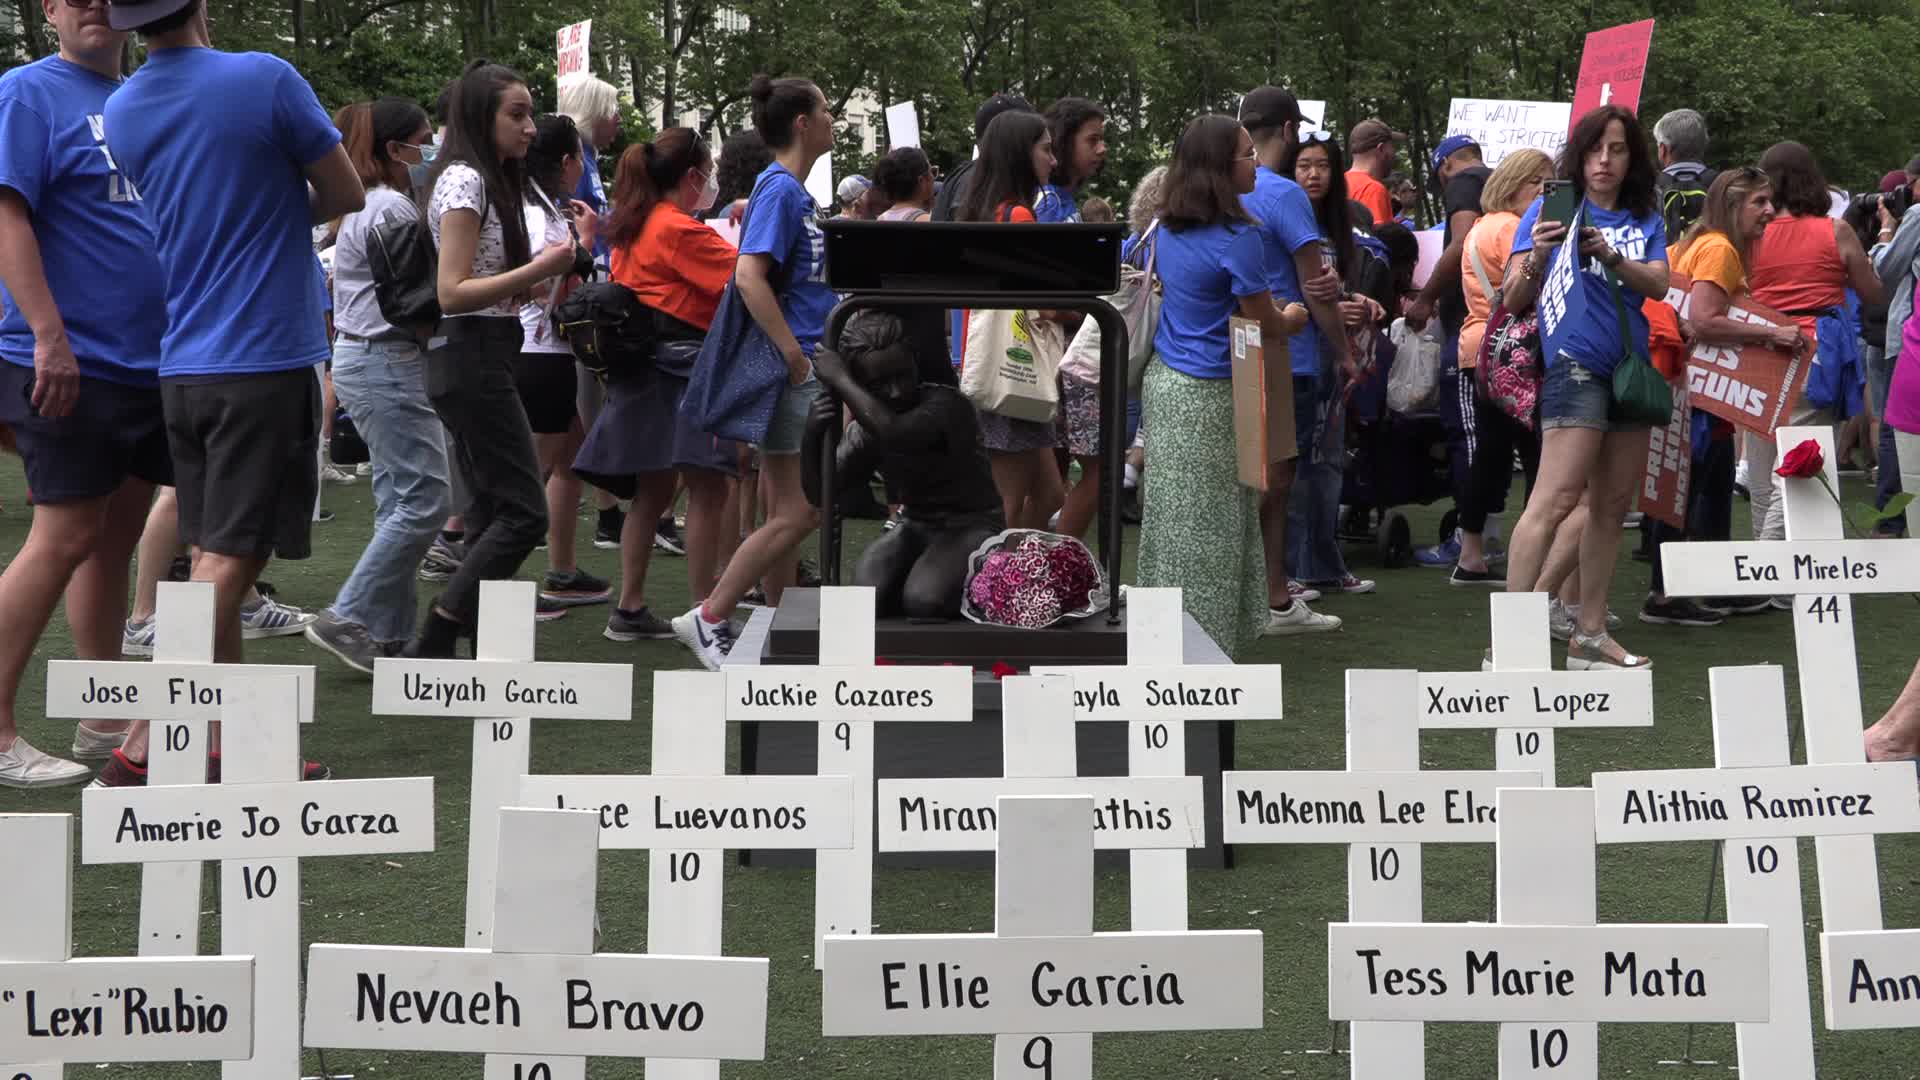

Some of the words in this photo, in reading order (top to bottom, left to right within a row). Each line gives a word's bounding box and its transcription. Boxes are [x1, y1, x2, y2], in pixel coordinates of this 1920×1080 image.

[1452, 102, 1475, 121] WE
[1485, 103, 1537, 124] WANT
[1686, 364, 1768, 418] GUNS
[1734, 555, 1779, 581] Eva
[1793, 554, 1878, 580] Mireles
[1807, 595, 1839, 623] 44
[81, 677, 138, 704] Jose
[168, 677, 222, 706] Flor
[404, 673, 486, 708] Uziyah
[505, 679, 578, 705] Garcia
[741, 679, 817, 707] Jackie
[835, 680, 933, 707] Cazares
[1075, 681, 1121, 711] ayla
[1145, 679, 1243, 706] Salazar
[1427, 686, 1510, 714] Xavier
[1533, 686, 1610, 721] Lopez
[166, 724, 190, 752] 10
[492, 721, 513, 742] 10
[835, 722, 851, 751] 9
[1144, 724, 1168, 749] 10
[1516, 732, 1540, 756] 10
[115, 807, 222, 843] Amerie
[241, 806, 281, 838] Jo
[301, 801, 400, 836] Garza
[655, 795, 807, 830] Luevanos
[899, 797, 997, 832] Miran
[1093, 798, 1172, 831] athis
[1237, 790, 1366, 825] Makenna
[1378, 790, 1425, 824] Lee
[1623, 789, 1729, 824] Alithia
[1741, 785, 1874, 820] Ramirez
[670, 852, 700, 883] 10
[1370, 847, 1400, 881] 10
[1745, 844, 1778, 874] 10
[242, 865, 277, 900] 10
[881, 962, 990, 1011] Ellie
[1031, 961, 1184, 1008] Garcia
[1355, 949, 1448, 996] Tess
[1465, 950, 1574, 997] Marie
[1604, 951, 1707, 997] Mata
[123, 987, 228, 1036] Rubio
[356, 972, 521, 1028] Nevaeh
[566, 979, 704, 1032] Bravo
[1022, 1035, 1053, 1080] 9
[1530, 1028, 1568, 1069] 10
